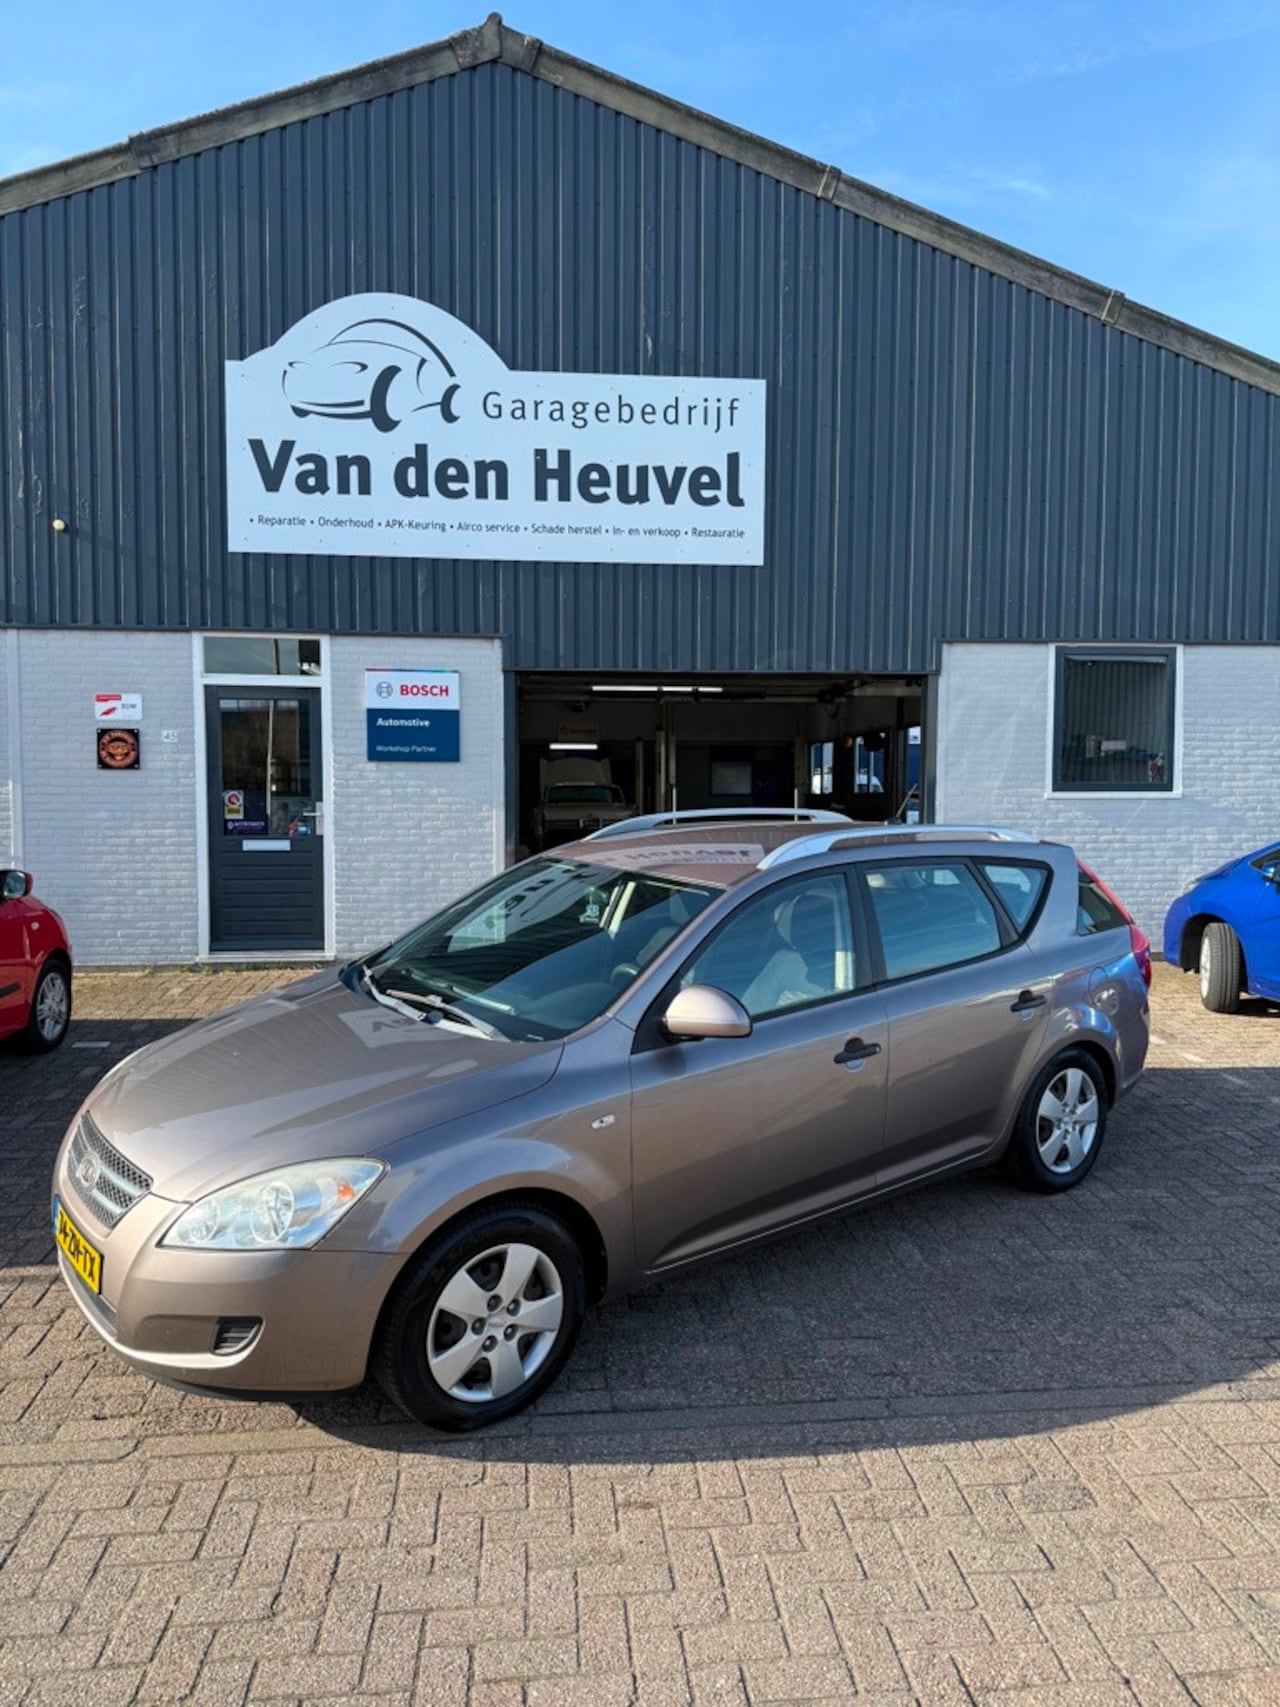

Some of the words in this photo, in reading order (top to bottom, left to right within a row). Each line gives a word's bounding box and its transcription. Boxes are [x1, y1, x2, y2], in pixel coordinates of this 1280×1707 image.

[482, 391, 740, 433] Garagebedrijf
[248, 438, 373, 497] Van
[393, 443, 510, 502] den
[534, 448, 746, 508] Heuvel
[257, 514, 307, 527] Reparatie
[317, 516, 374, 529] Onderhoud
[384, 519, 447, 533] APK-Keuring
[456, 522, 482, 533] Airco
[485, 523, 521, 534] service
[531, 523, 565, 535] Schade
[568, 524, 601, 536] herstel
[627, 527, 641, 536] en
[642, 527, 681, 539] verkoop
[691, 527, 746, 539] Restauratie
[400, 684, 449, 697] BOSCH
[376, 717, 431, 728] Automotive
[376, 744, 411, 753] Workshop
[411, 744, 437, 753] Partner
